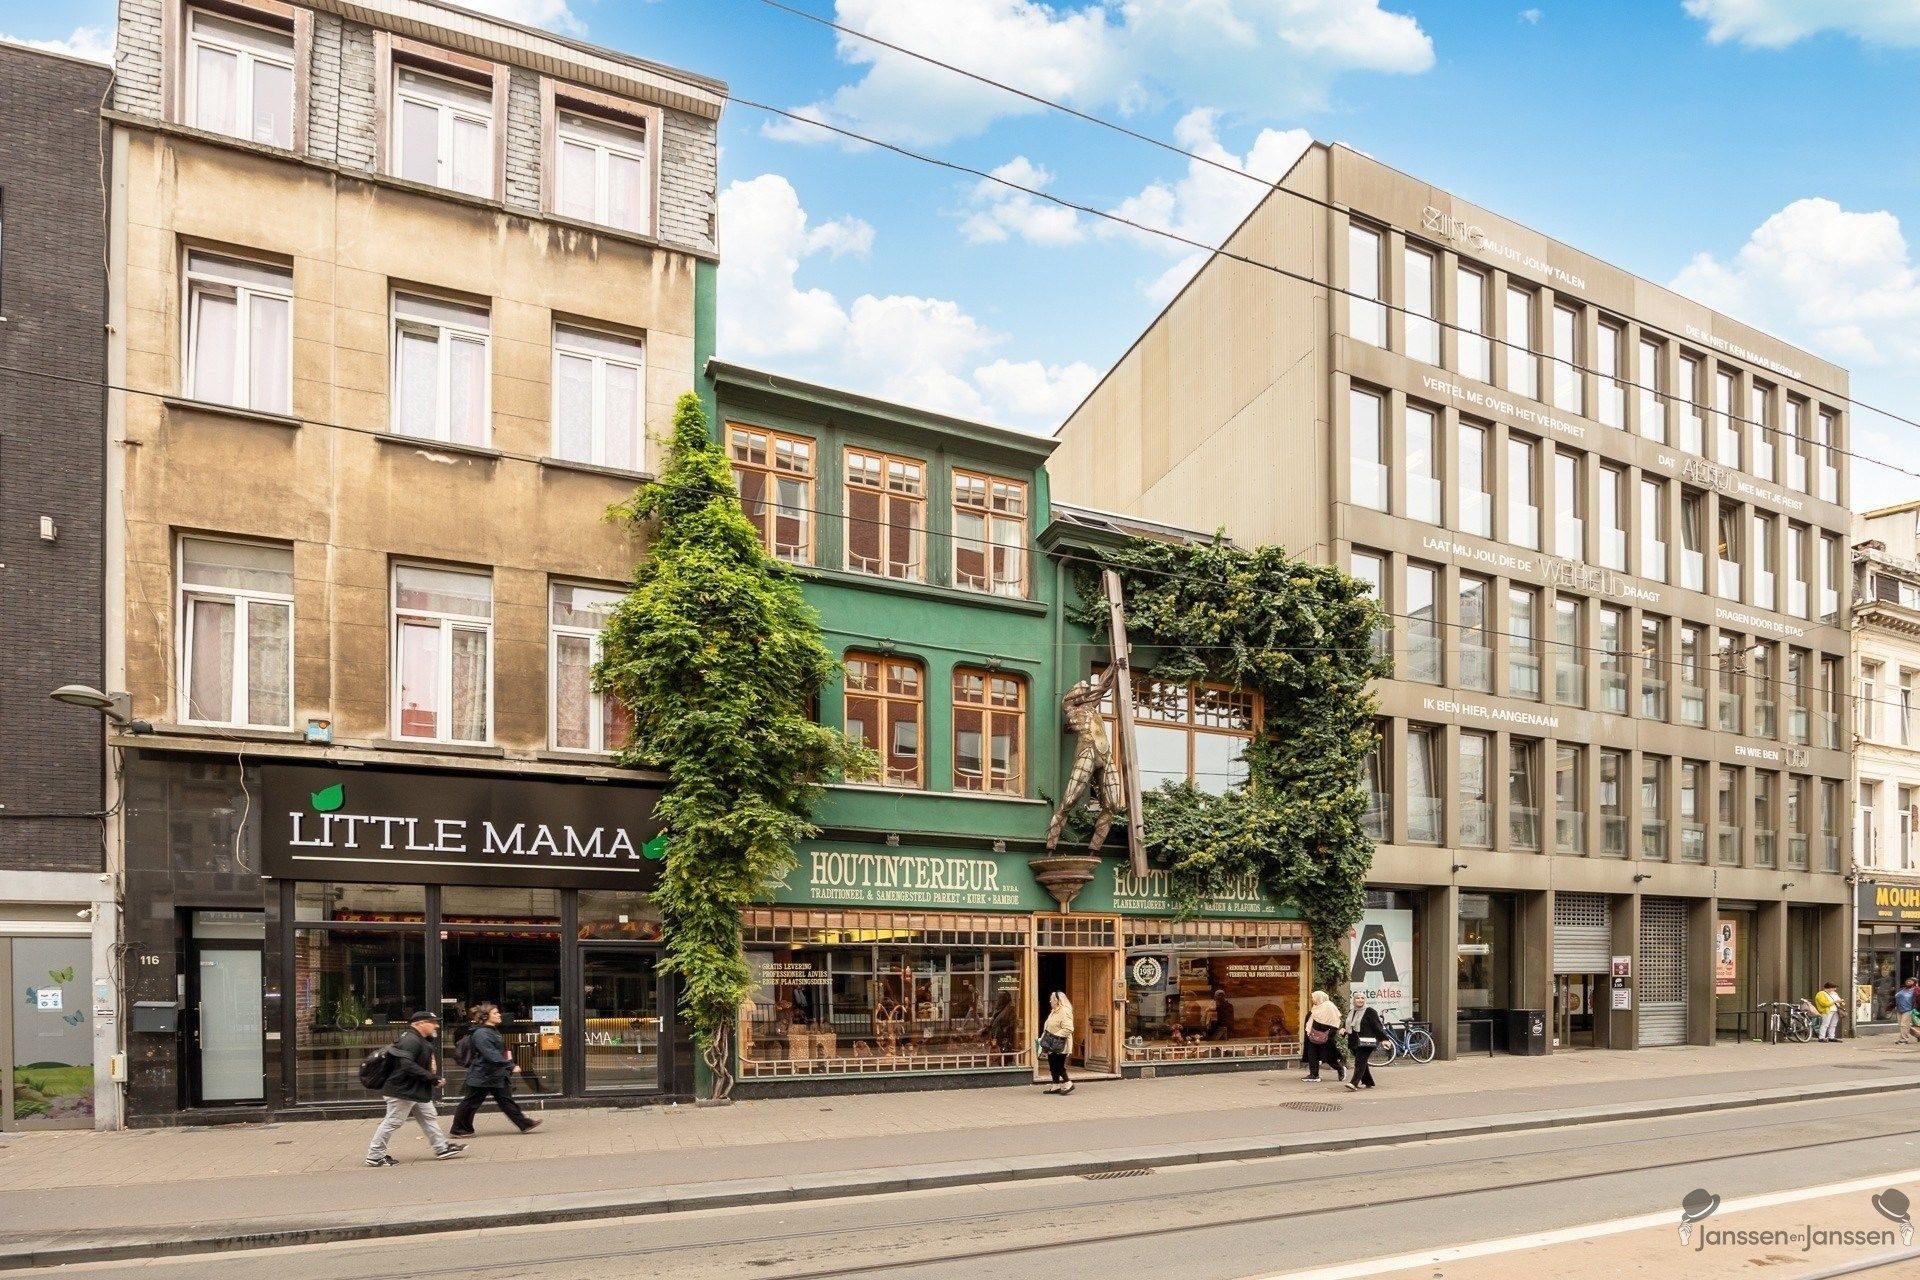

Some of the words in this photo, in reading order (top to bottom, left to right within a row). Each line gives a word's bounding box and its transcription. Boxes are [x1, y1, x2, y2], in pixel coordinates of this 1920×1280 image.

[1483, 239, 1503, 254] MIJ
[1505, 246, 1521, 262] UIT
[1523, 253, 1554, 276] JOUW
[1554, 268, 1586, 290] TALEN
[1686, 325, 1700, 338] DIE
[1709, 336, 1728, 350] NIET
[1729, 343, 1746, 358] KEN
[1747, 350, 1770, 367] MAAR
[1422, 375, 1465, 399] VERTEL
[1467, 390, 1483, 405] ME
[1485, 397, 1514, 415] OVER
[1516, 406, 1536, 422] HET
[1536, 413, 1586, 438] VERDRIET
[1658, 454, 1676, 468] DAT
[1738, 482, 1755, 495] MEE
[1755, 487, 1772, 500] MET
[1771, 493, 1782, 504] JE
[1781, 495, 1803, 511] REIST
[1423, 536, 1451, 553] LAAT
[1452, 542, 1472, 557] MIJ
[1473, 548, 1497, 565] JOU,
[1499, 554, 1516, 568] DIE
[1518, 560, 1532, 572] DE
[1623, 584, 1661, 603] DRAAGT
[1716, 608, 1750, 625] DRAGEN
[1750, 616, 1772, 630] DOOR
[1773, 622, 1783, 632] DE
[1784, 625, 1804, 637] STAD
[1423, 697, 1435, 710] IK
[1437, 699, 1459, 714] BEN
[1462, 704, 1490, 719] HIER,
[1491, 708, 1559, 728] AANGENAAM
[1735, 745, 1746, 755] EN
[1747, 747, 1762, 758] WIE
[1763, 749, 1779, 760] BEN
[289, 811, 467, 853] LITTLE
[482, 821, 640, 860] MAMA
[810, 851, 999, 891] HOUTINTERIEUR
[810, 888, 865, 900] TRADITIONEEL
[866, 890, 874, 900] &
[876, 890, 931, 902] SAMENGESTELD
[933, 892, 960, 903] PARKET
[967, 894, 986, 904] KURK
[992, 894, 1019, 905] BAMBOE
[1113, 898, 1166, 910] PLANKENVLOEREN
[1227, 903, 1233, 912] &
[1234, 903, 1261, 912] PLAFONDS
[1876, 887, 1920, 907] MOUH
[140, 955, 160, 965] 116
